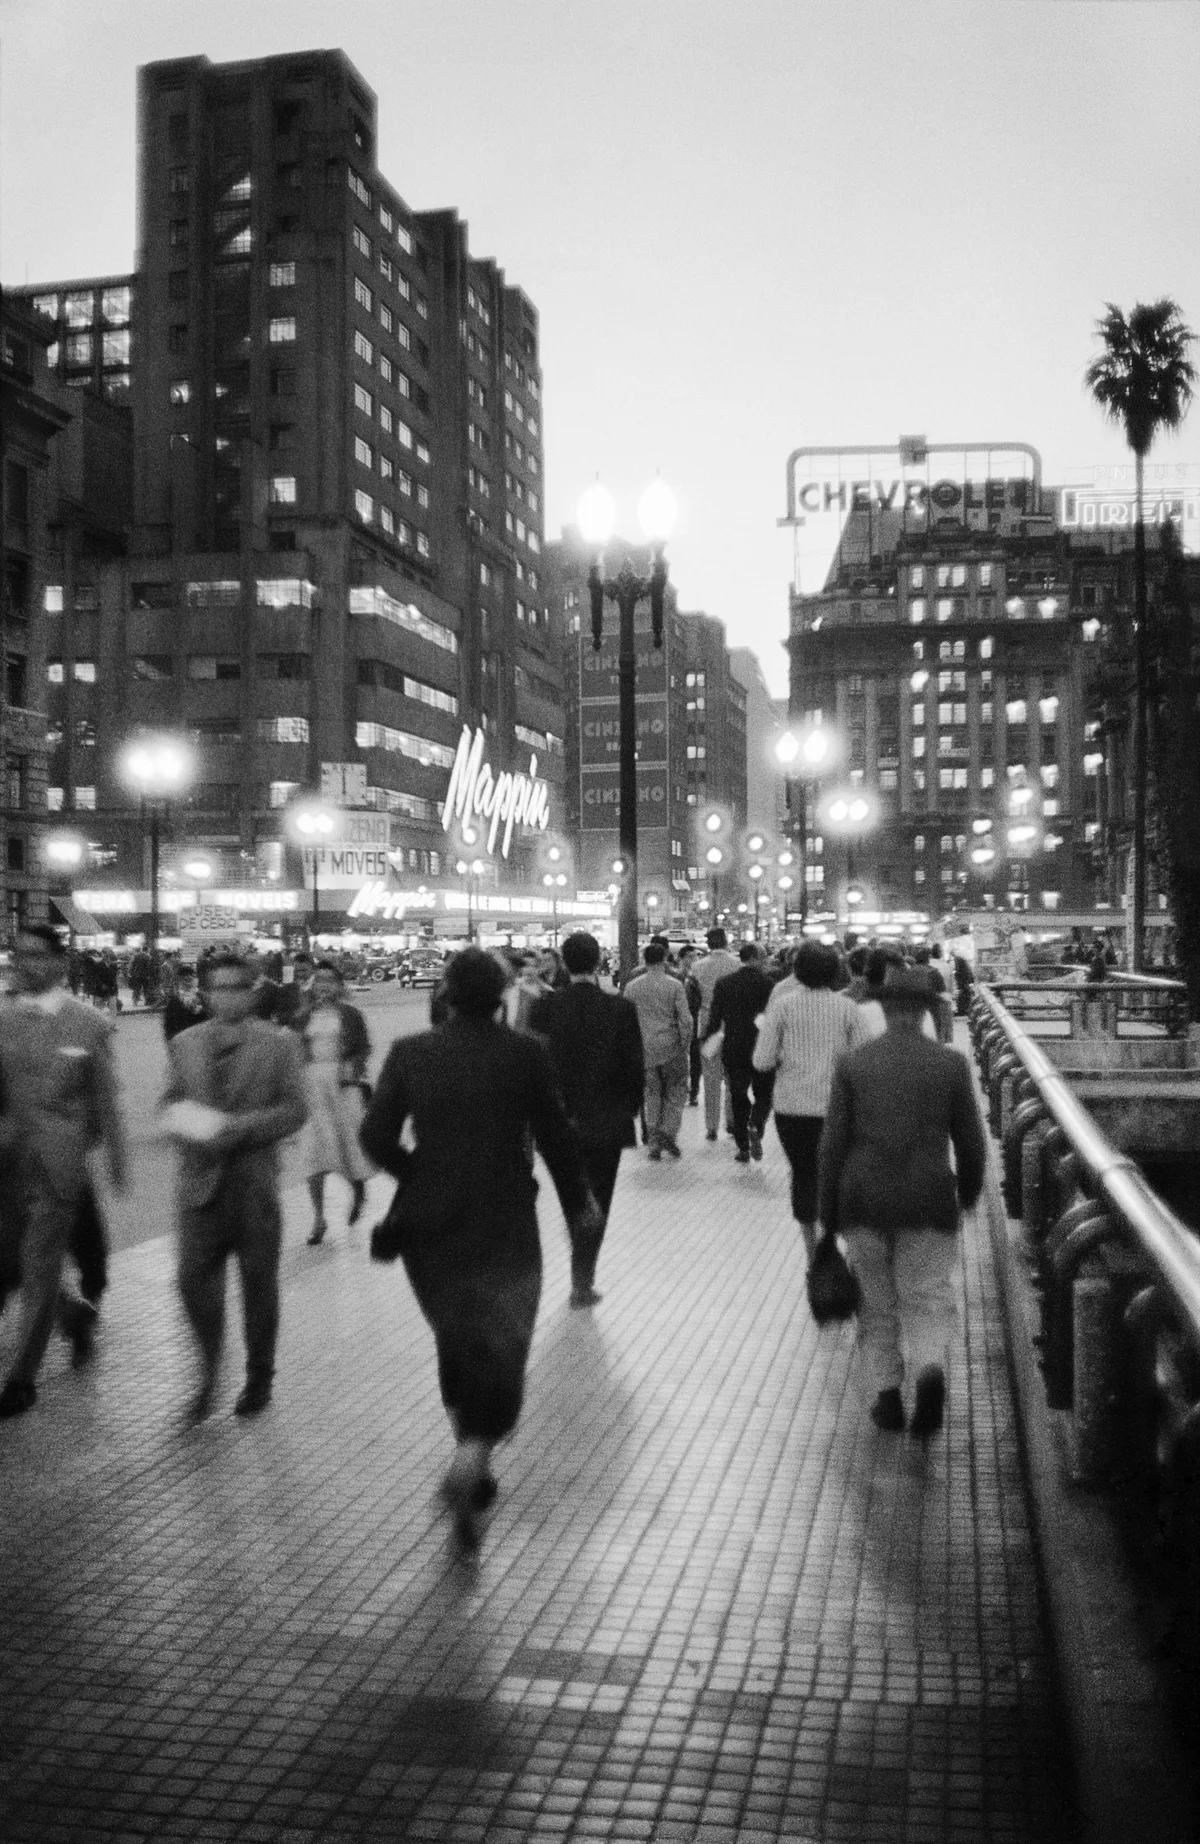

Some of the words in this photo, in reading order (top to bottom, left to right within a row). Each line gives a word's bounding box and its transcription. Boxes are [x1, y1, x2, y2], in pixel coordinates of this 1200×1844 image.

[1093, 464, 1188, 481] PNUS
[800, 477, 1034, 512] CHEVROLET
[584, 652, 664, 671] CINZNO
[584, 719, 664, 737] CINZNO
[441, 723, 550, 859] Mappin
[584, 786, 665, 804] CINZNO
[331, 851, 386, 876] MOVEIS
[217, 892, 297, 910] MOVEIS
[179, 917, 197, 930] DE
[199, 917, 237, 930] CERA
